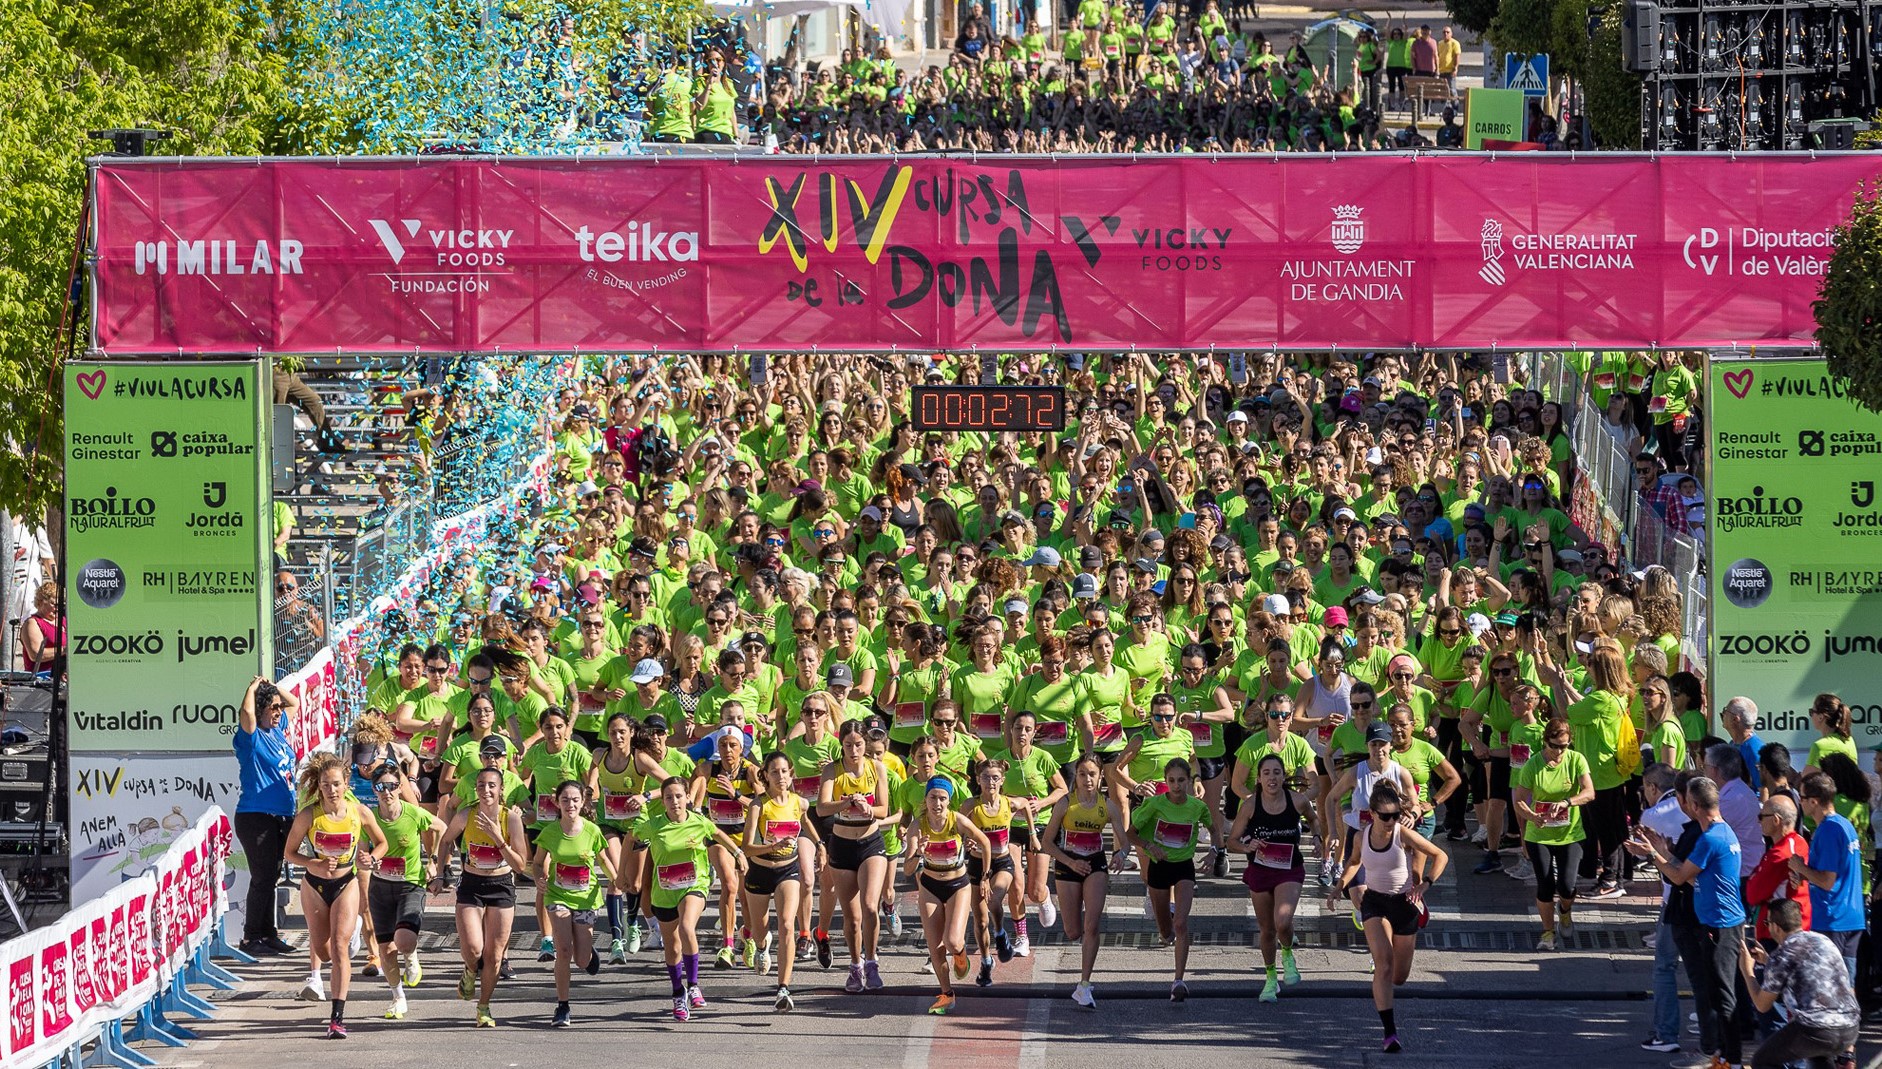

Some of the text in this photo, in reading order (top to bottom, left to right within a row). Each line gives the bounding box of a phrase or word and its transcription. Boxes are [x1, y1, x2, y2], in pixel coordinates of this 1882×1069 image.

[1475, 122, 1512, 135] CARROS
[758, 166, 1032, 273] XIV CURSA
[429, 229, 514, 248] VICKY
[574, 220, 699, 262] teika
[1132, 228, 1232, 250] VICKY
[1512, 233, 1638, 250] GENERALITAT
[178, 239, 304, 275] MILAR
[437, 253, 506, 266] FOODS
[1142, 255, 1222, 271] FOODS
[1513, 253, 1635, 270] VALENCIANA
[1742, 255, 1831, 275] de Valèn
[586, 267, 687, 290] EL BUEN VENDING
[1280, 259, 1416, 280] AJUNTAMENT
[391, 275, 490, 293] FUNDACIÓN
[886, 226, 1072, 344] DONA
[1291, 283, 1404, 301] DE GANDIA
[1761, 376, 1850, 399] #VIULAC
[922, 393, 1054, 426] 00:02:72
[72, 431, 134, 445] Renault
[182, 431, 228, 444] caixa
[1718, 431, 1781, 444] Renault
[1830, 430, 1876, 442] caixa
[71, 447, 141, 460] Ginestar
[182, 442, 254, 458] popular
[1718, 447, 1788, 460] Ginestar
[1830, 441, 1882, 456] popul
[70, 514, 156, 534] NATURALFRUIT
[1717, 513, 1803, 533] NATURALFRUIT
[82, 578, 119, 592] Aquarel
[143, 572, 255, 586] RH BAYREN
[1729, 578, 1766, 591] Aquarel
[1790, 572, 1882, 586] RH BAYRE
[178, 586, 200, 595] Hotel
[208, 587, 225, 596] Spa
[1825, 586, 1848, 594] Hotel
[1856, 586, 1873, 595] Spa
[177, 628, 255, 663] jumel
[1824, 629, 1882, 663] jum
[173, 704, 241, 724] ruan
[1754, 710, 1809, 731] aldin
[76, 766, 125, 800] XIV
[124, 778, 155, 799] CURSA
[174, 776, 216, 803] DONA
[80, 815, 117, 845] ANEM
[98, 828, 126, 853] ALLÀ
